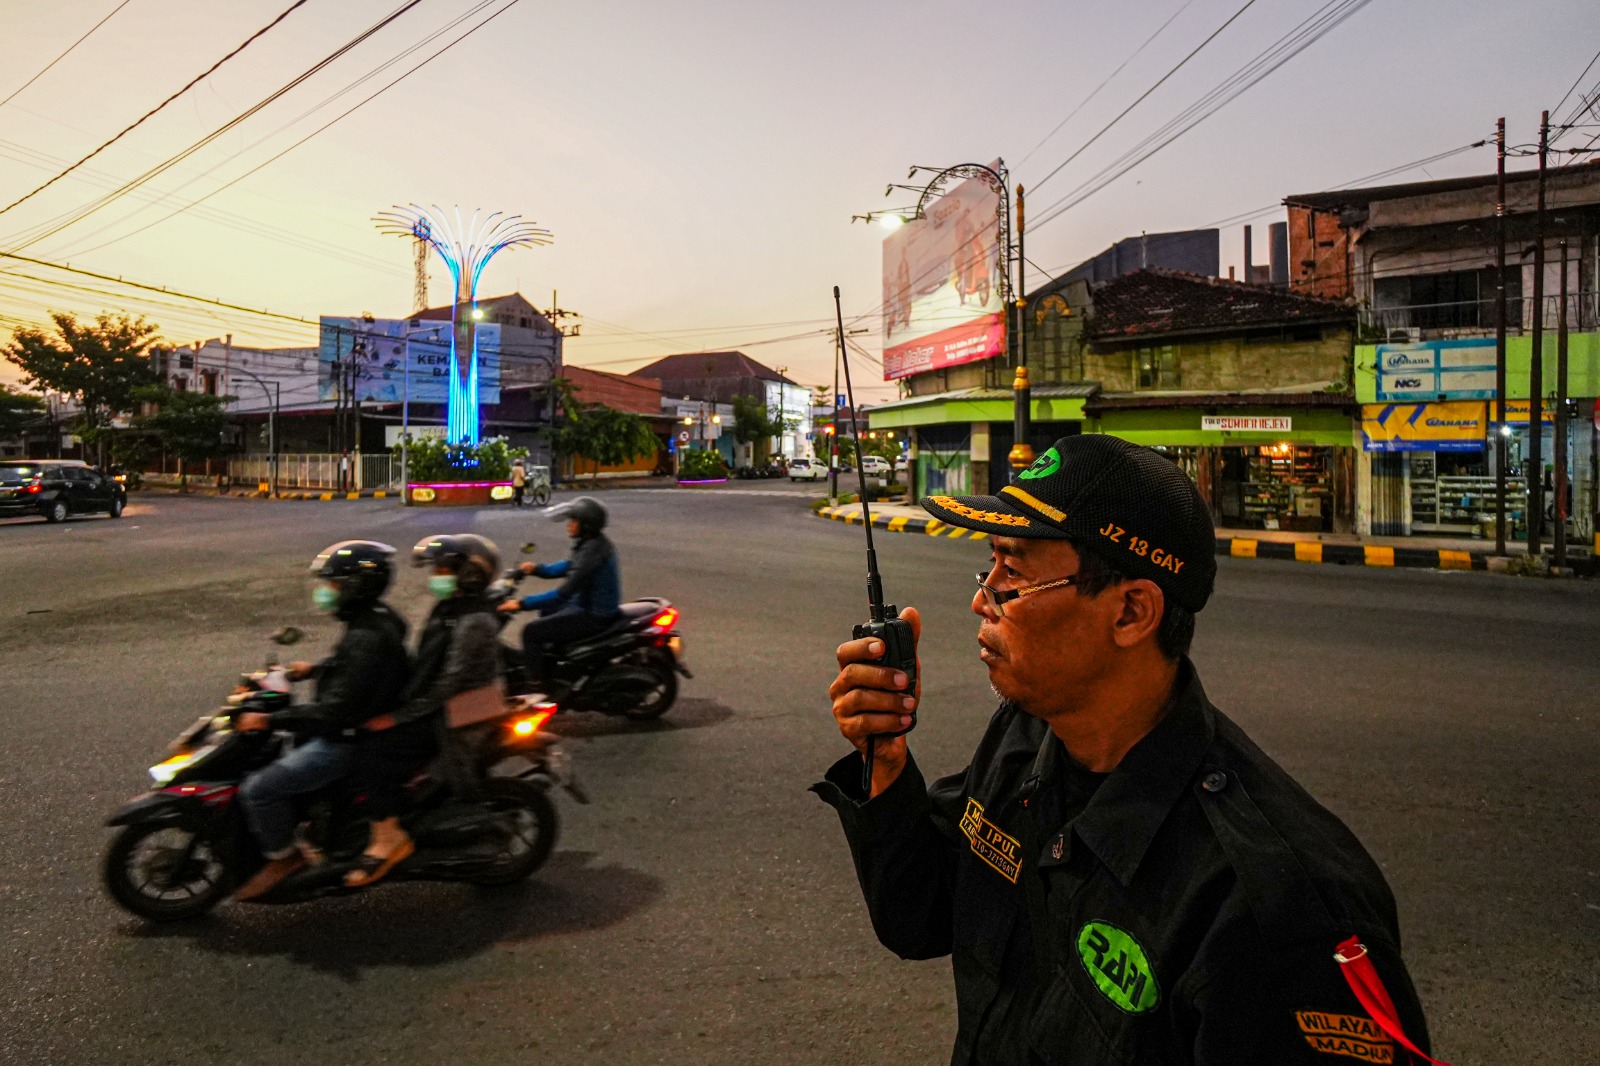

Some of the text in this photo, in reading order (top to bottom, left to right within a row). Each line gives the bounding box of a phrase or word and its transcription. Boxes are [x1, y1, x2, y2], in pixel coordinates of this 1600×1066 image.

[1099, 522, 1185, 575] JZ 13 GAY
[985, 828, 1016, 861] IPUL
[1086, 928, 1148, 1009] RAPI
